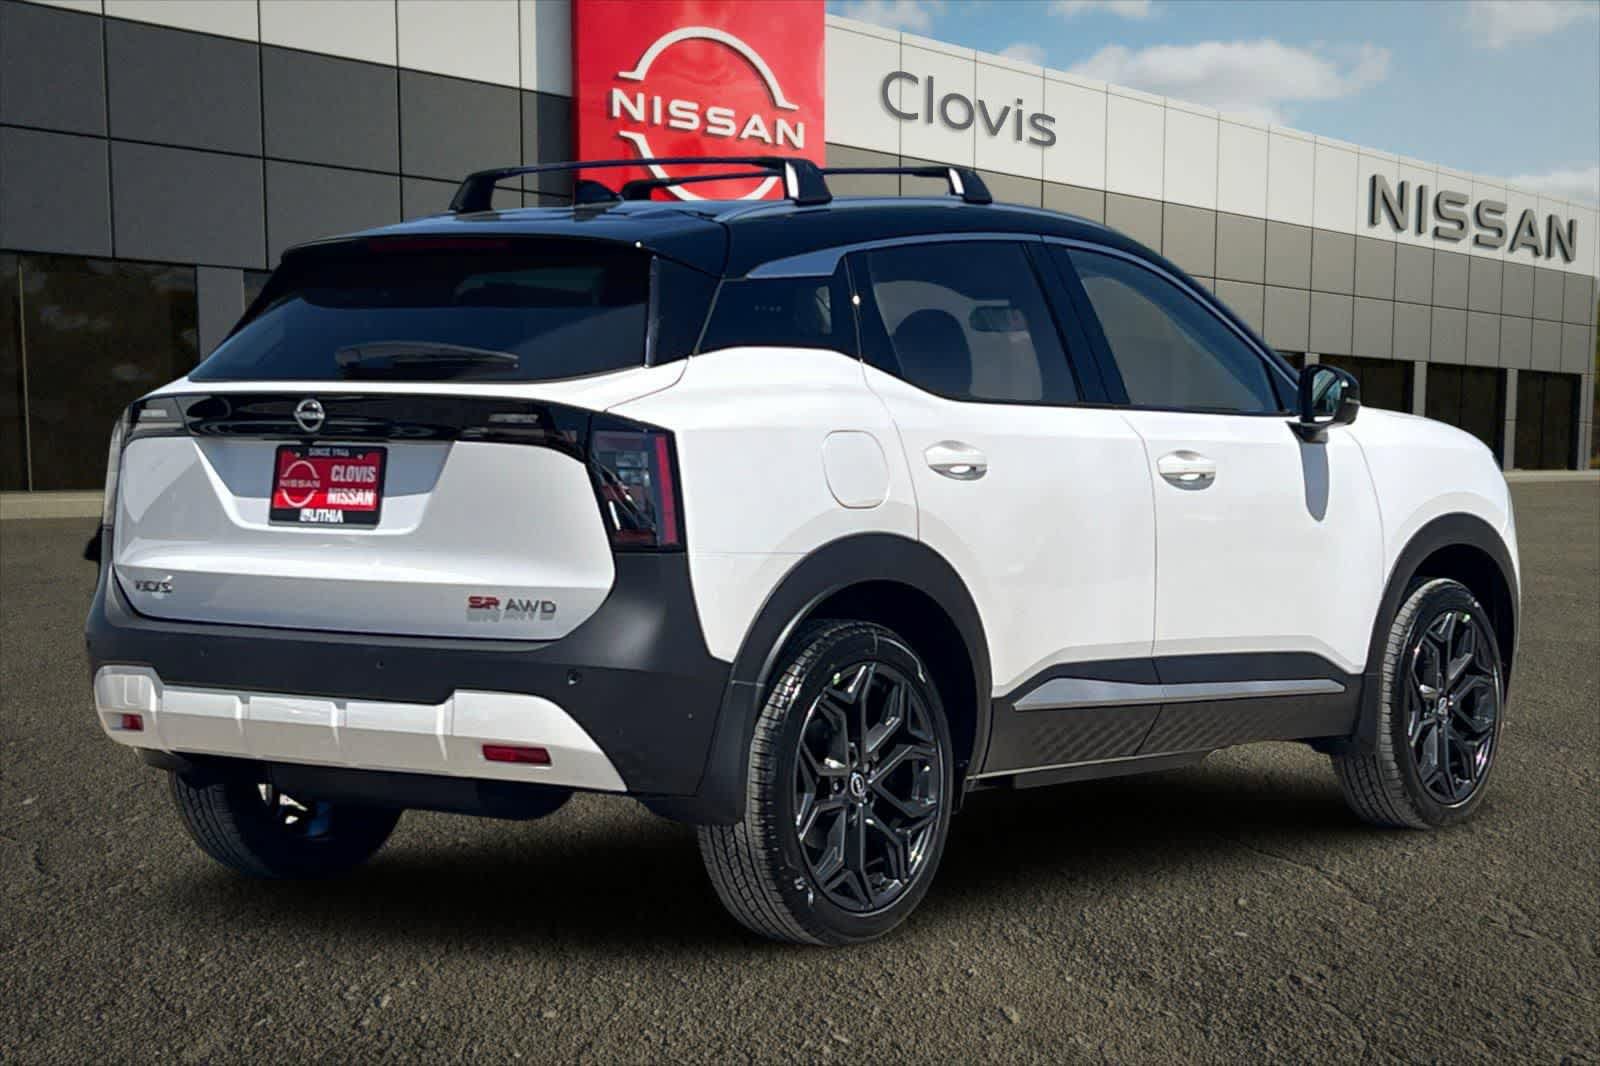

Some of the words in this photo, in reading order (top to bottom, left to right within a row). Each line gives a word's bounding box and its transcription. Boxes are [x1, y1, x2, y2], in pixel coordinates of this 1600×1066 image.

[611, 87, 805, 149] NISSAN
[876, 70, 1057, 147] Clovis
[1368, 173, 1577, 264] NISSAN
[330, 464, 376, 483] CLOVIS
[279, 479, 321, 488] NISSAN
[326, 488, 375, 506] NISSAN
[468, 595, 501, 610] SR
[505, 598, 557, 614] AWD
